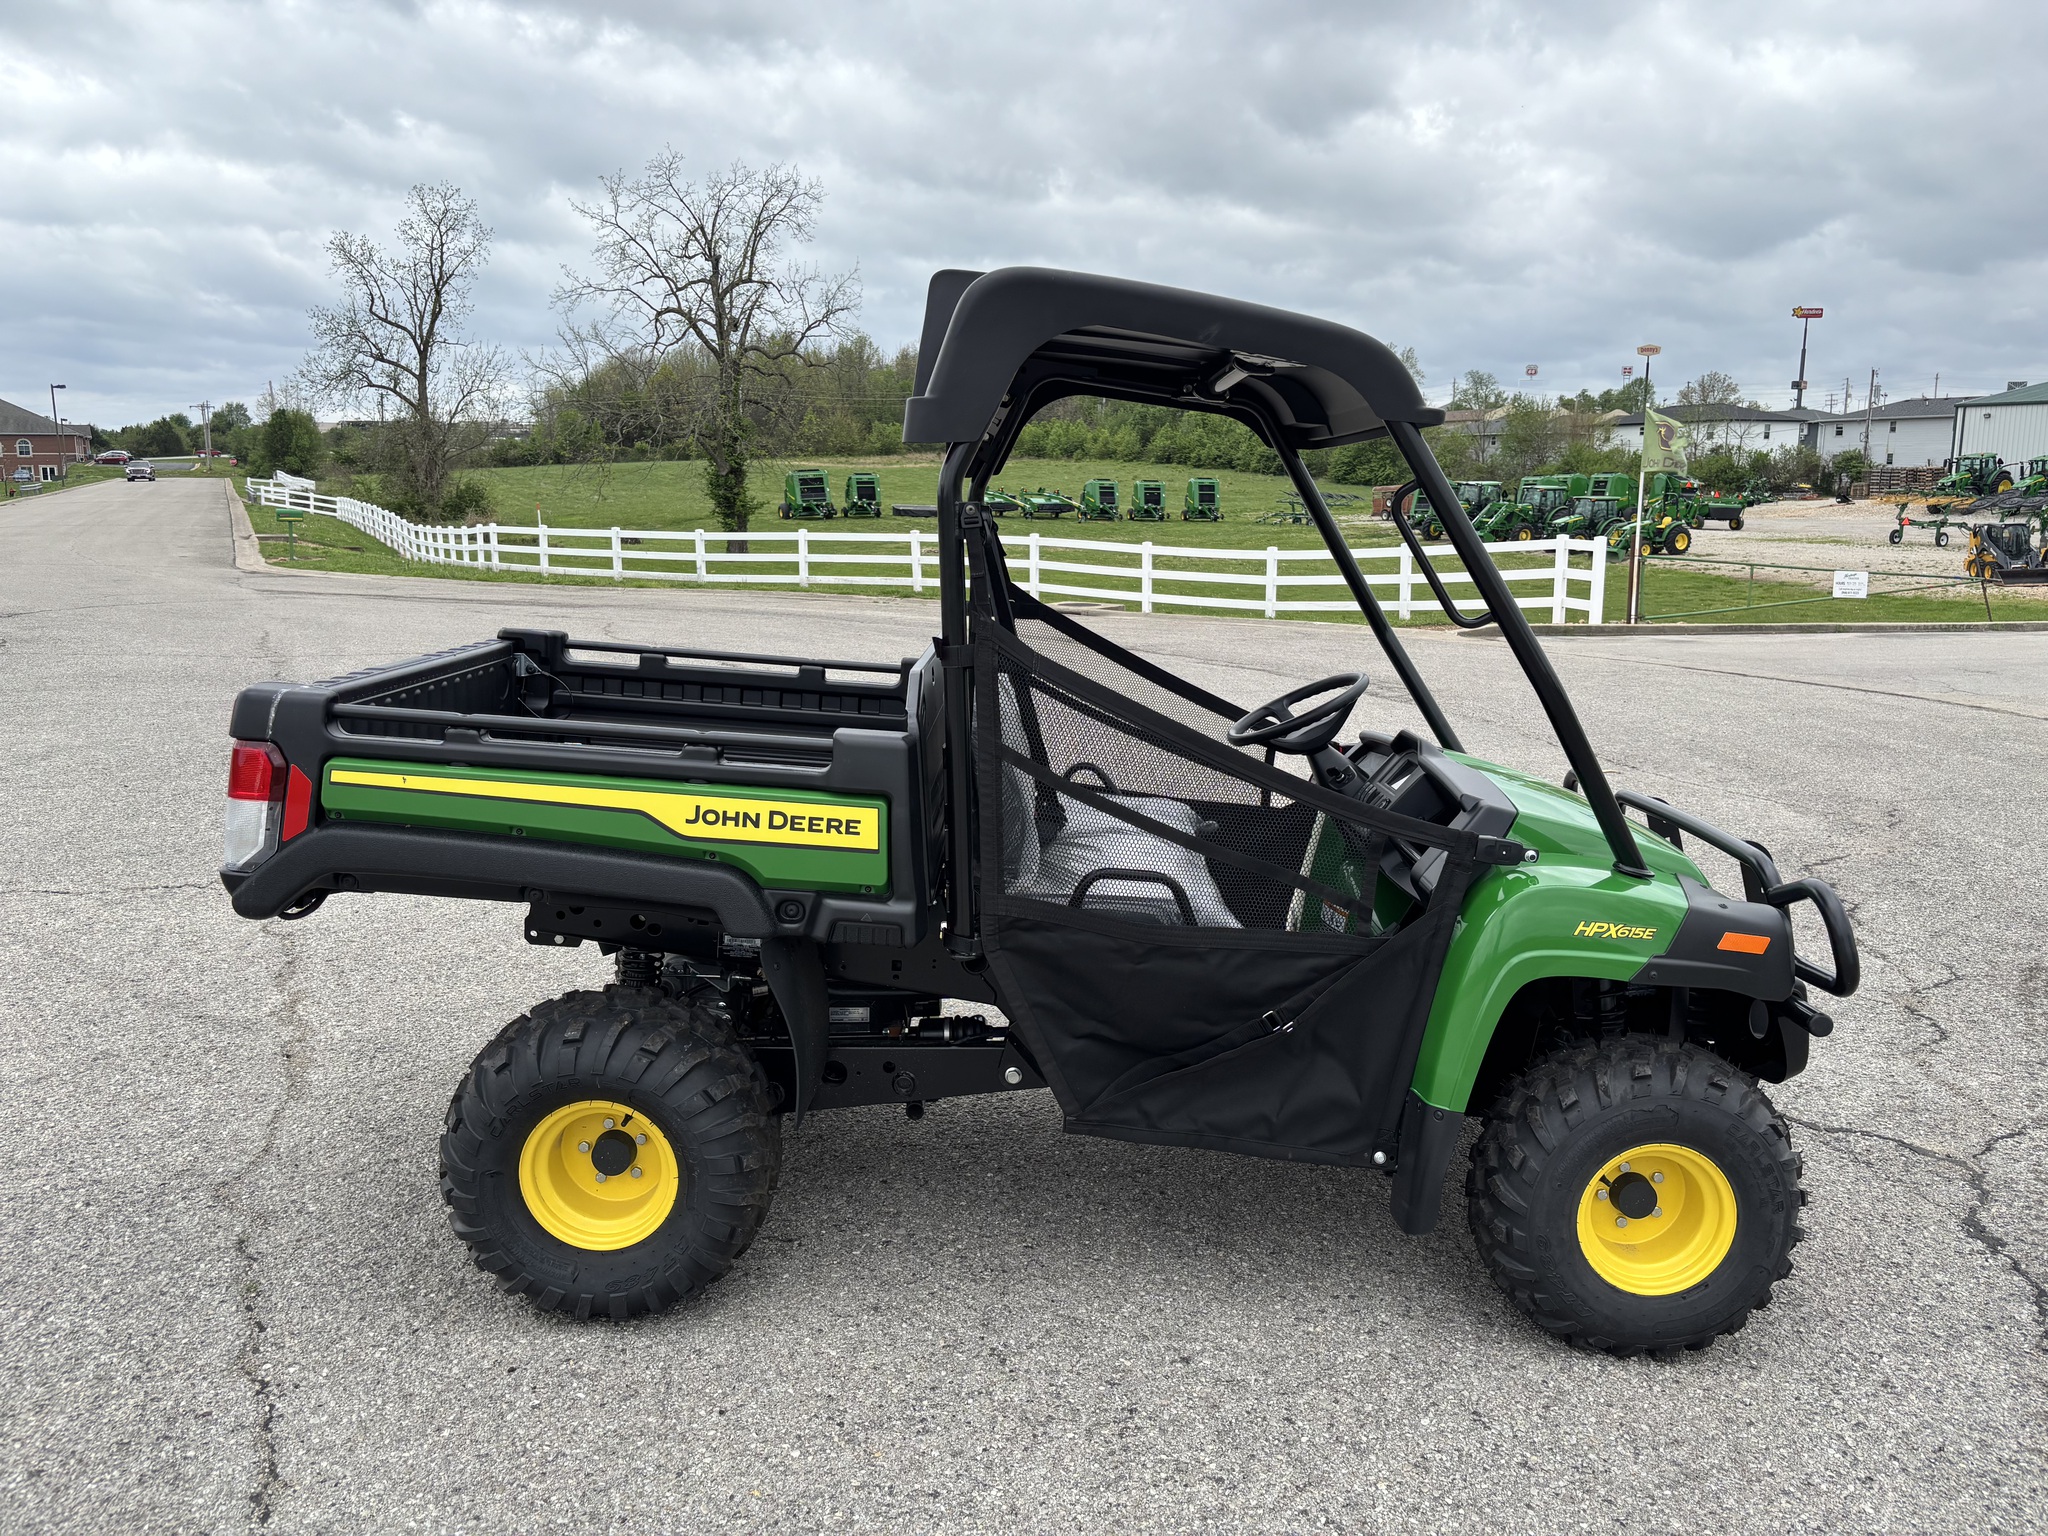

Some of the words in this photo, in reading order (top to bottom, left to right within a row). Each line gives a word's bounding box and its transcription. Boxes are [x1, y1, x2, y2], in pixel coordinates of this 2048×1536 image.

[685, 805, 760, 829] JOHN
[768, 810, 861, 836] DEERE
[1572, 921, 1658, 940] HPX615E
[489, 1077, 582, 1139] CARLSTAR
